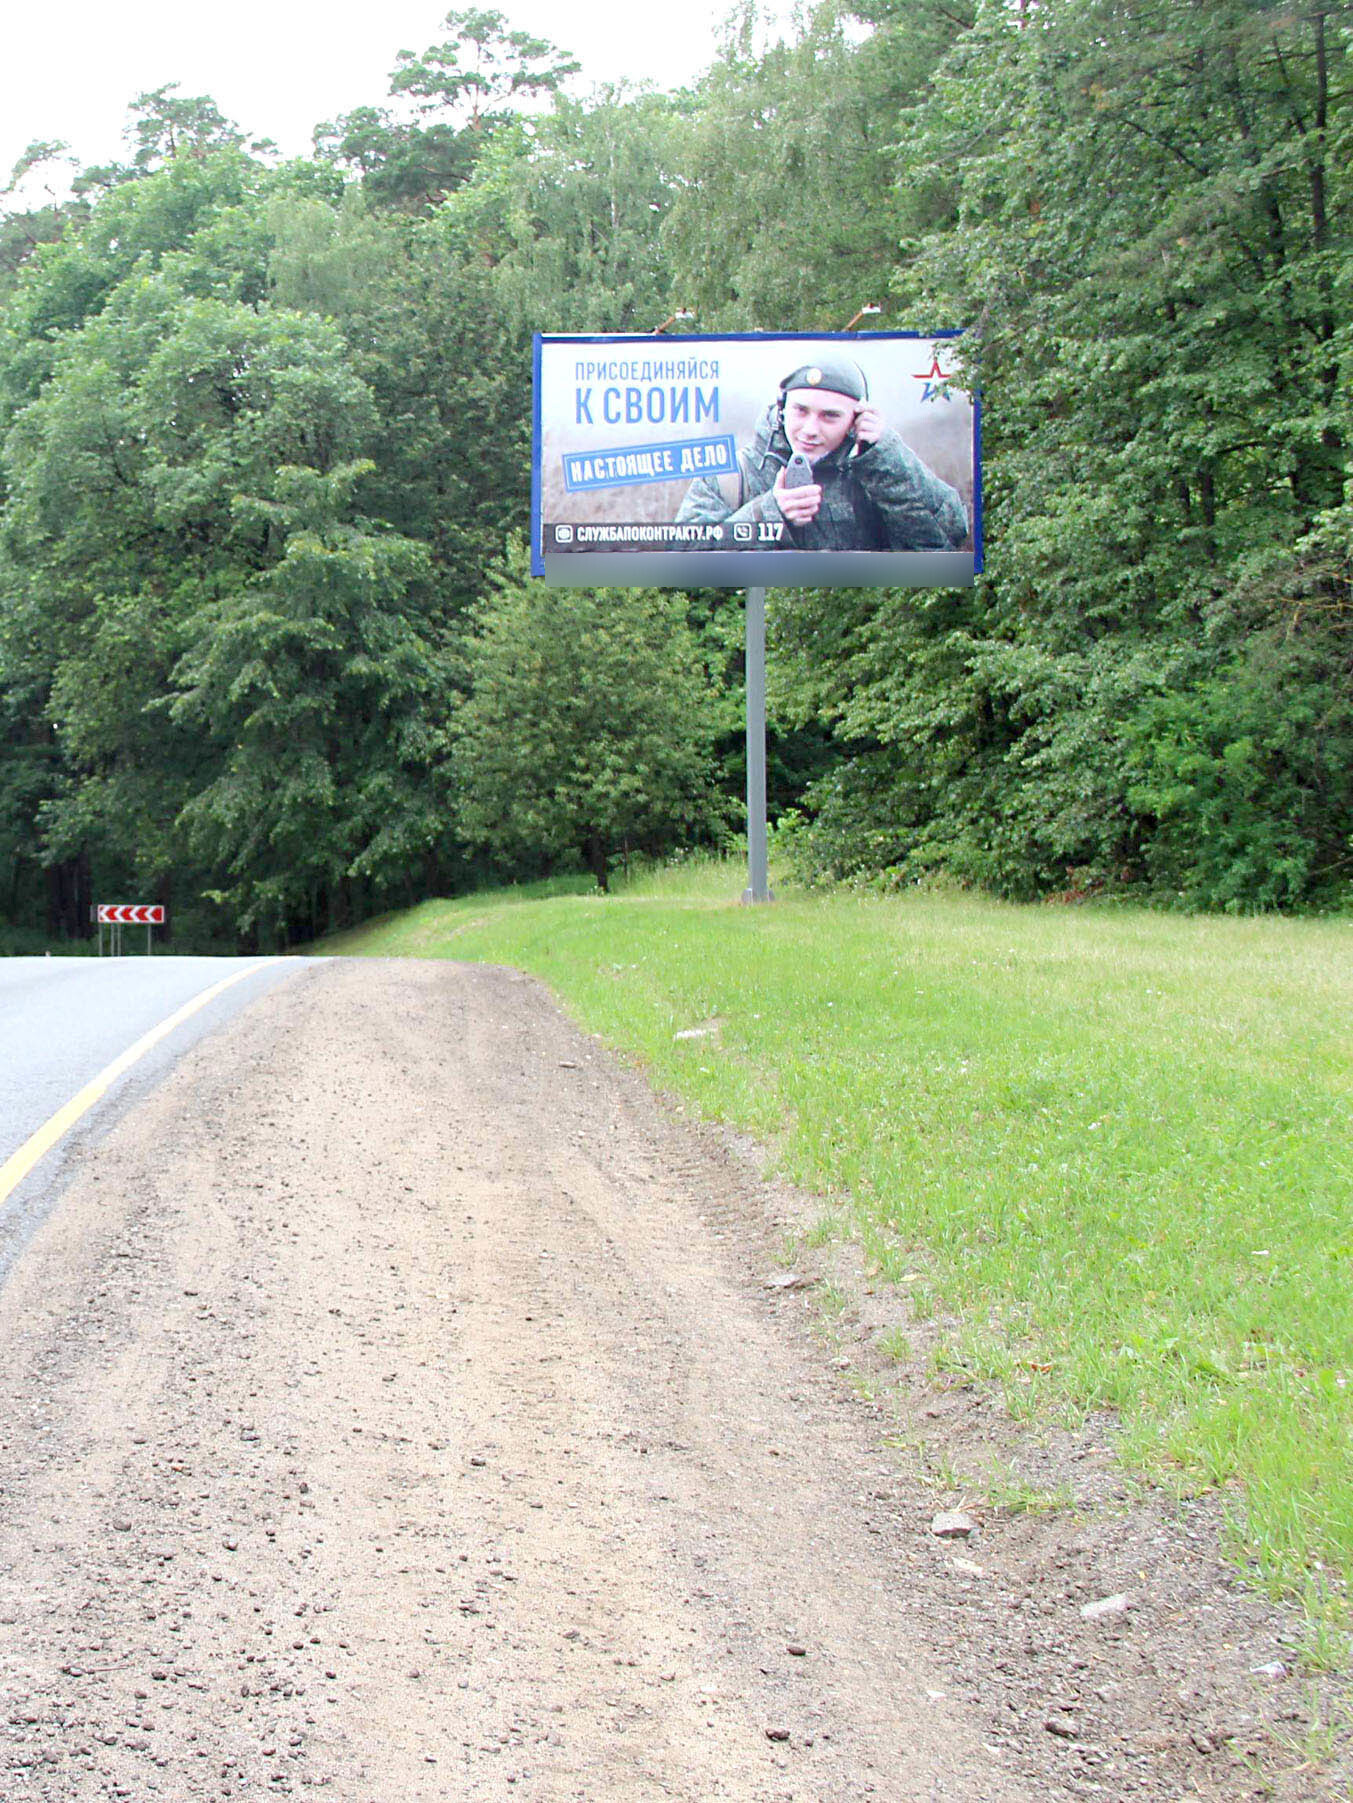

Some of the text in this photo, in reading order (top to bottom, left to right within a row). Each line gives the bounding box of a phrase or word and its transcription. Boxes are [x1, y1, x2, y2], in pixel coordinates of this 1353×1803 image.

[575, 356, 719, 382] ПРИСОЕДИНЯЙСЯ
[575, 386, 719, 424] К СВОИМ
[570, 444, 727, 483] НАСТОЯЩЕЕ ДЕЛО
[576, 525, 723, 542] СЛУЖБАПОКОНТРАКТУ.РФ
[757, 523, 784, 541] 117
